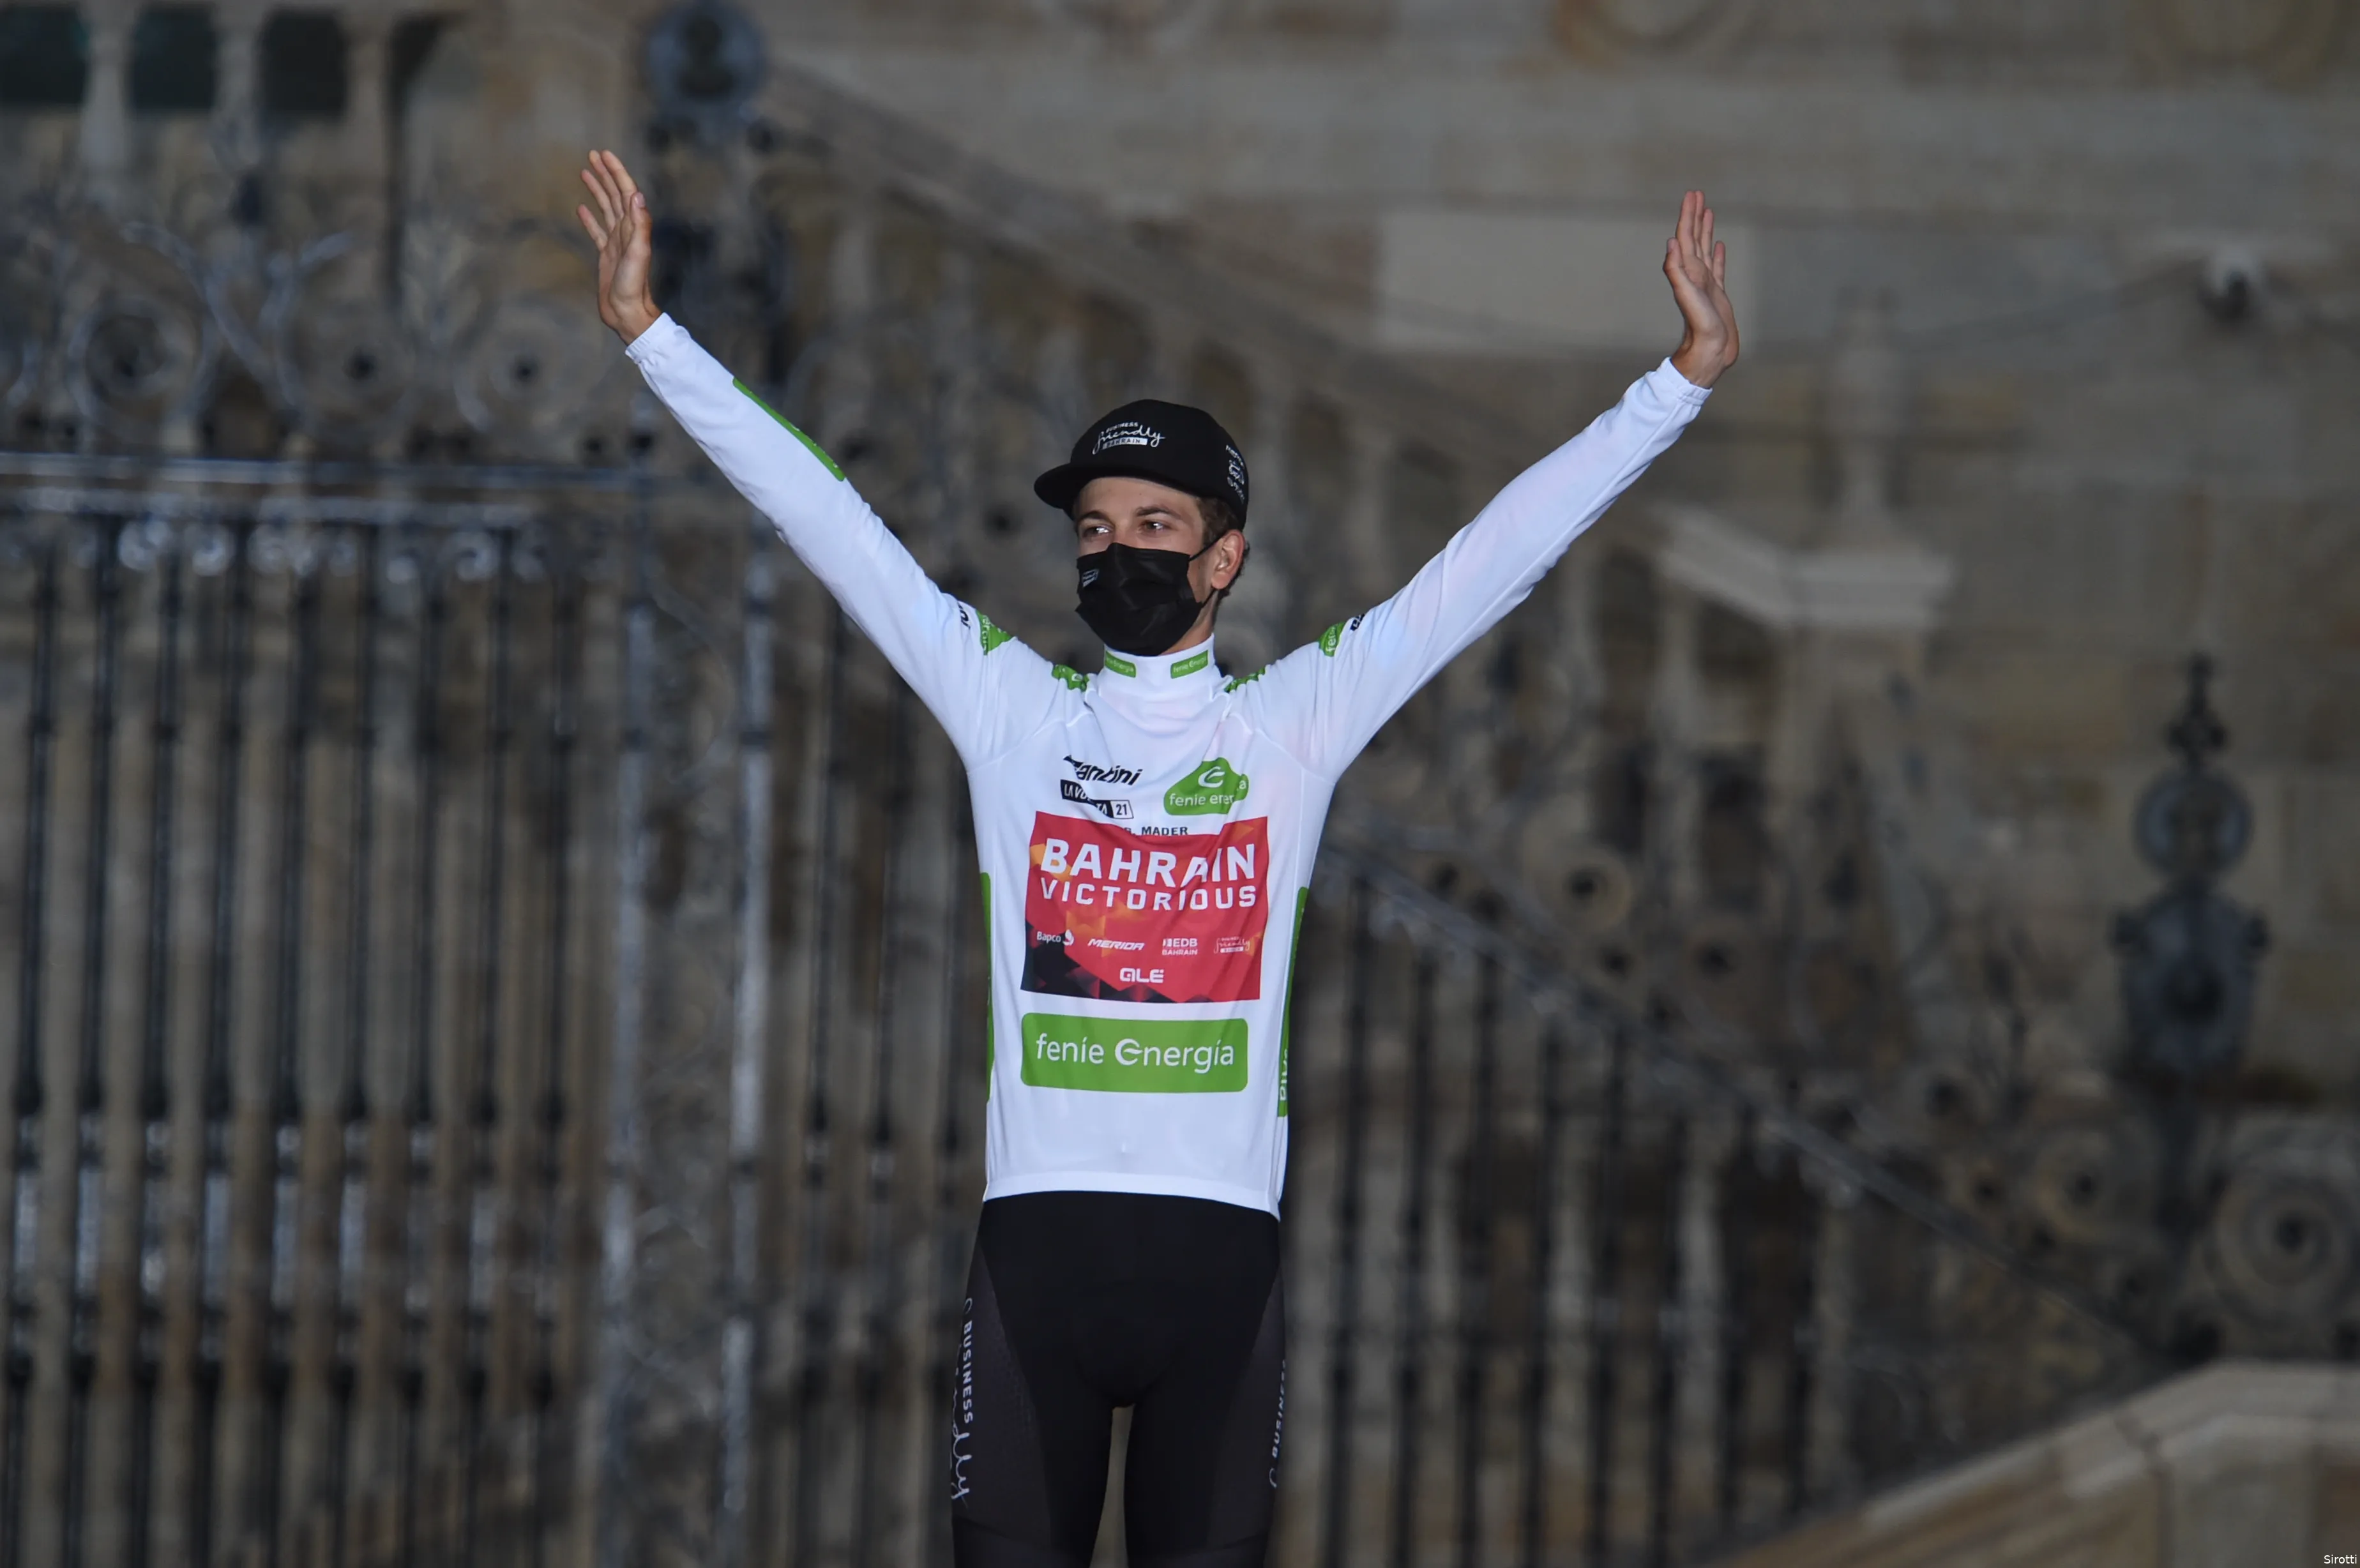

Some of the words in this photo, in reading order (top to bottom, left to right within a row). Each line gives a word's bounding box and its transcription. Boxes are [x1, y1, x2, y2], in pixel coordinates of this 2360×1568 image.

[1116, 803, 1128, 816] 21
[1141, 825, 1189, 836] MADER
[1041, 838, 1255, 888] BAHRAIN
[1040, 877, 1257, 911] VICTORIOUS
[1036, 931, 1061, 944] Bapco
[1087, 939, 1145, 951] MERIDA
[962, 1320, 973, 1424] BUSINESS
